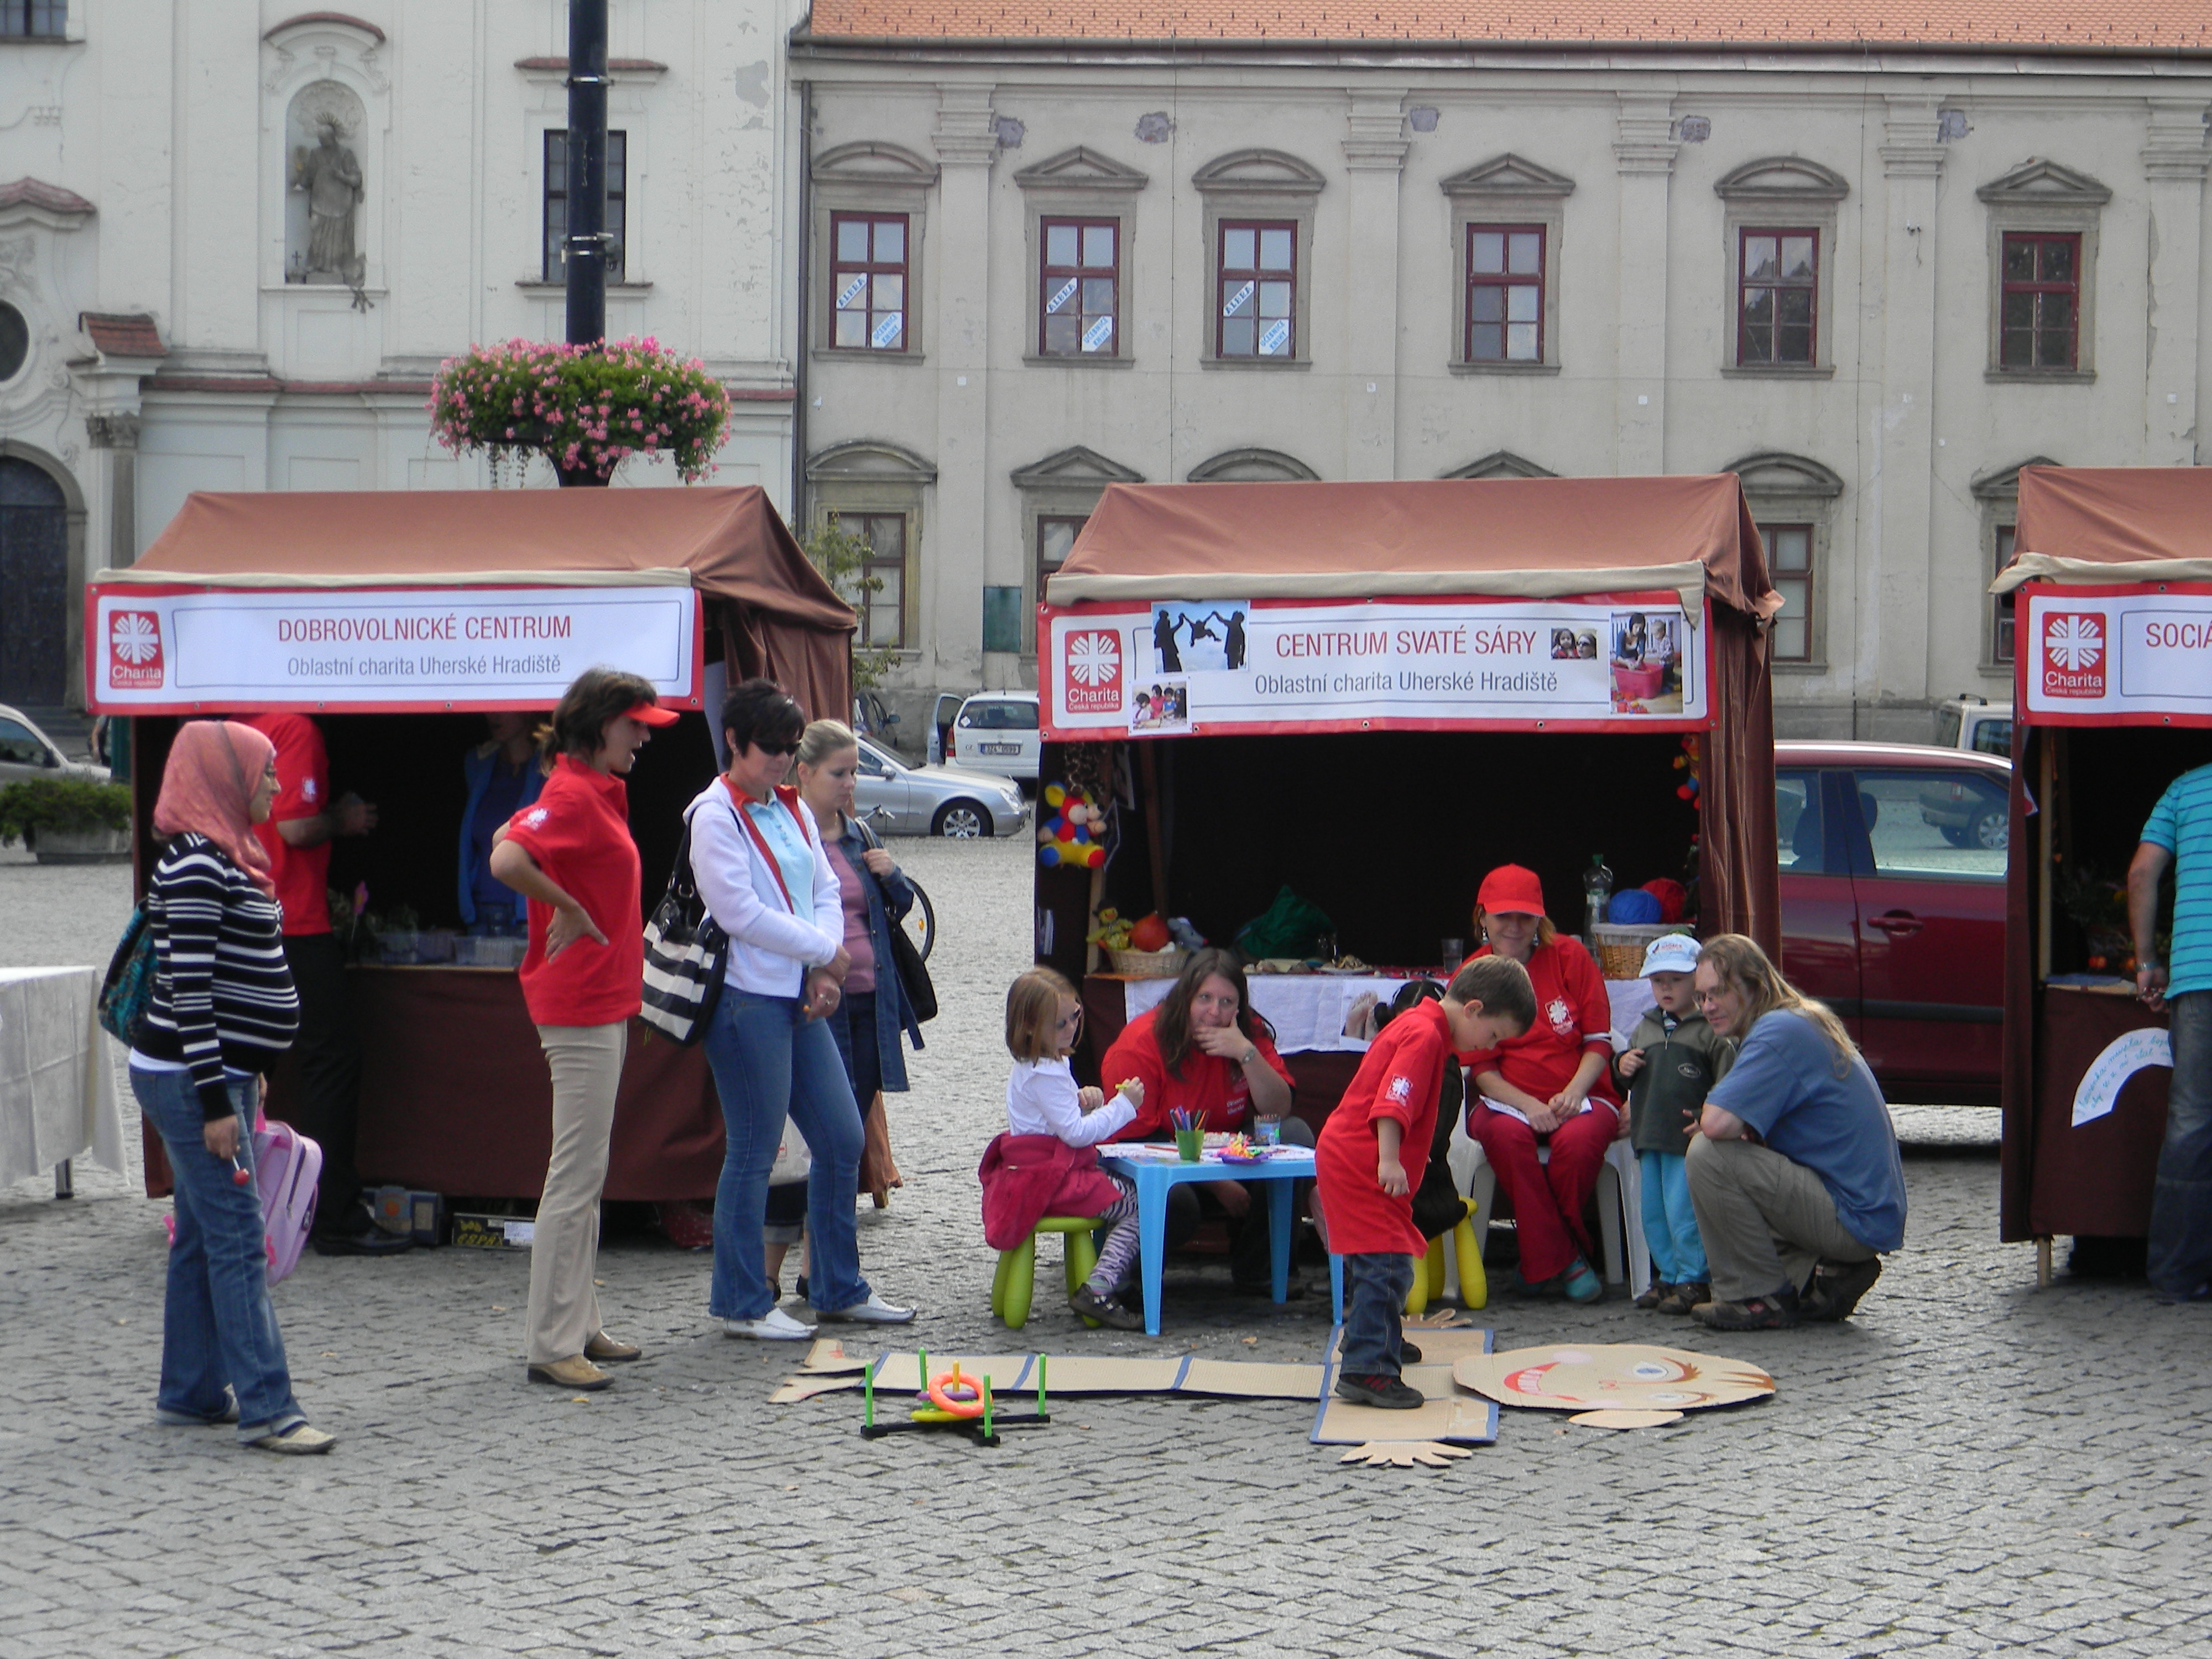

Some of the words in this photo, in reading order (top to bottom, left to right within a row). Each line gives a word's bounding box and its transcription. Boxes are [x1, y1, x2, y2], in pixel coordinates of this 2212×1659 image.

[279, 613, 457, 642] DOBROVOLNICKÉ
[465, 615, 571, 640] CENTRUM
[1276, 631, 1387, 658] CENTRUM
[1396, 624, 1466, 654] SVATÉ
[1475, 624, 1536, 654] SÁRY
[112, 665, 161, 680] Charita
[288, 657, 354, 676] Oblastní
[359, 657, 415, 676] charita
[420, 655, 487, 675] Uherské
[493, 653, 561, 674] Hradiště
[1255, 672, 1327, 694] Oblastní
[1334, 671, 1392, 692] charita
[1399, 670, 1474, 692] Uherské
[1481, 671, 1557, 691] Hradiště
[2046, 671, 2103, 687] Charita
[1068, 687, 1119, 703] Charita
